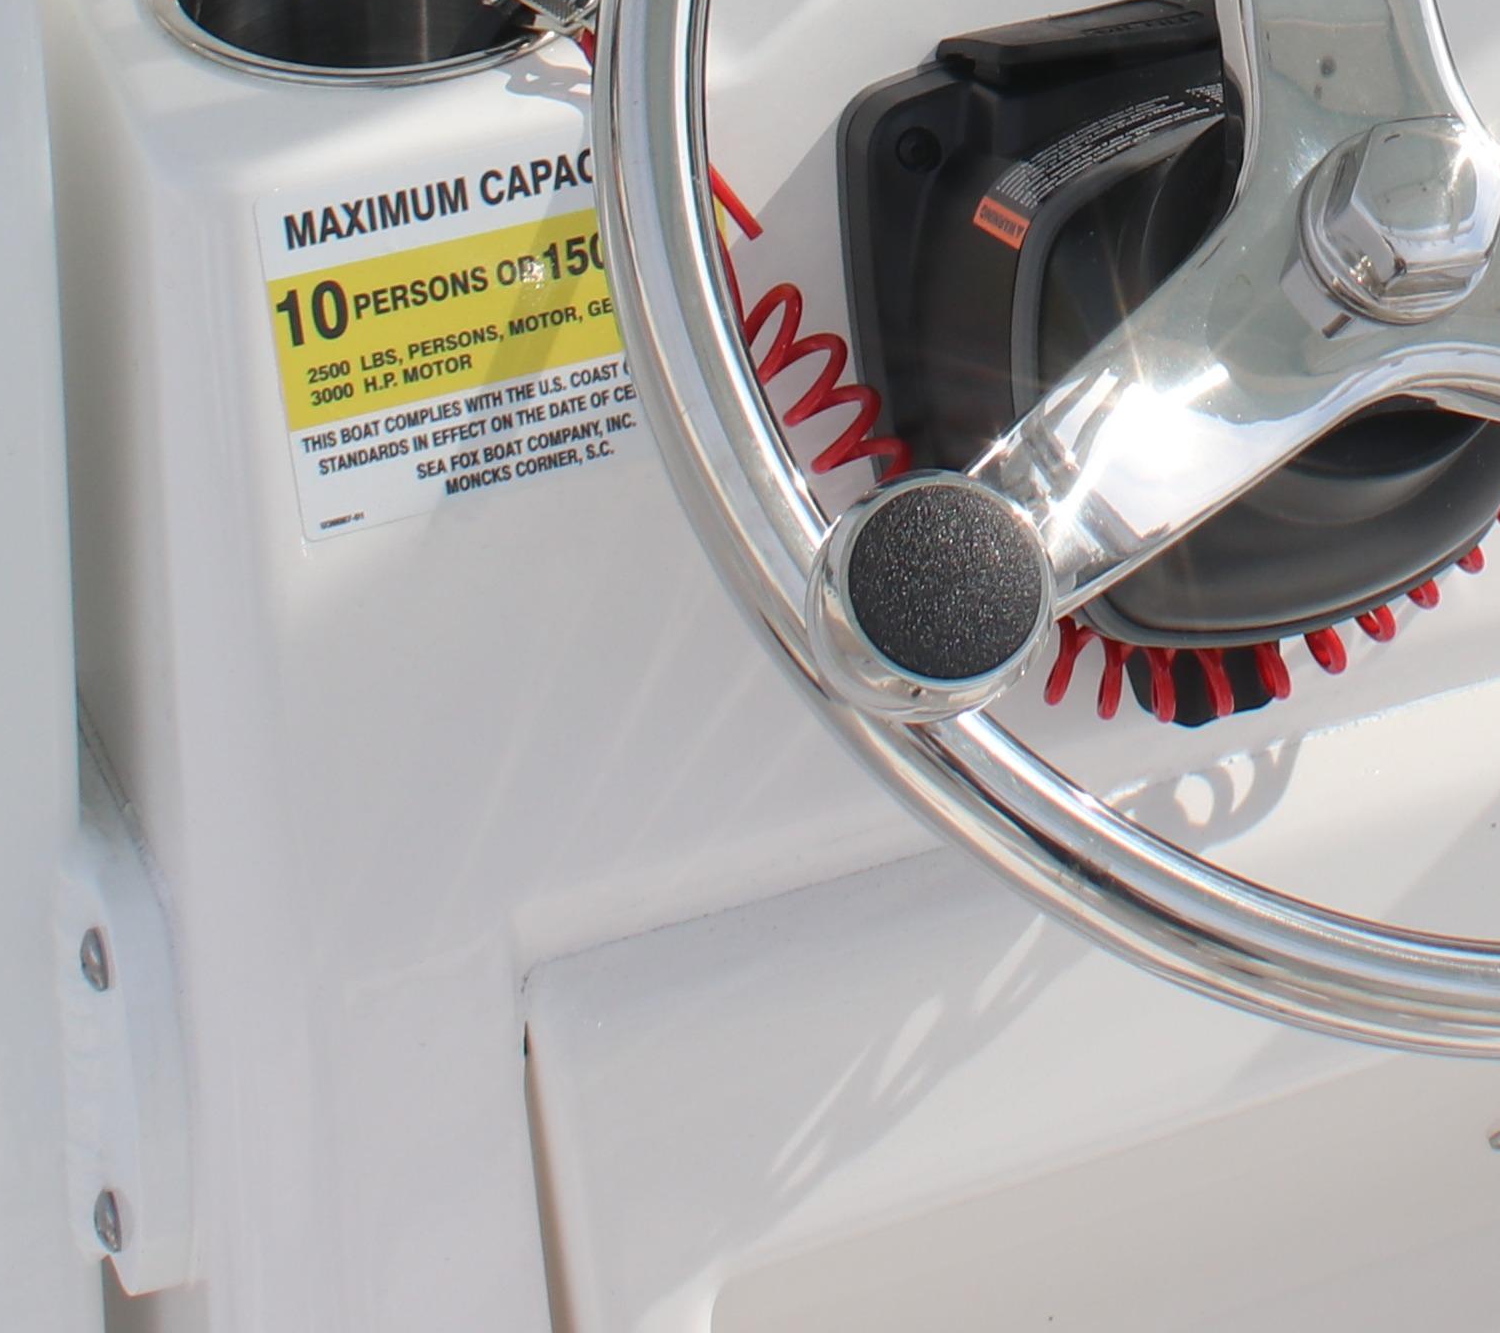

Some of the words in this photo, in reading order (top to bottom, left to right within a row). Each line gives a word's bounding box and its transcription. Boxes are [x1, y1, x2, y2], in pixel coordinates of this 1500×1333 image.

[283, 175, 470, 251] MAXIMUM
[274, 276, 351, 350] 10
[352, 264, 489, 320] PERSONS
[306, 359, 350, 384] 2500
[360, 347, 403, 374] LBS,
[407, 323, 504, 362] PERSONS,
[508, 304, 583, 338] MOTOR,
[301, 429, 338, 453] THIS
[338, 418, 382, 444] BOAT
[382, 399, 462, 433] COMPLIES
[463, 389, 503, 414] WITH
[504, 381, 536, 404] THE
[537, 374, 567, 396] U.S.
[568, 362, 619, 389] COAST
[309, 382, 354, 407] 3000
[363, 371, 398, 393] H.P.
[402, 353, 472, 384] MOTOR
[318, 438, 410, 475] STANDARDS
[411, 432, 429, 453] IN
[430, 418, 488, 448] EFFECT
[489, 412, 514, 433] ON
[515, 404, 546, 427] THE
[547, 394, 587, 419] DATE
[588, 388, 611, 409] OF
[416, 457, 447, 480] SEA
[448, 449, 481, 472] FOX
[481, 438, 524, 464] BOAT
[525, 419, 603, 455] COMPANY,
[604, 411, 636, 434] INC.
[445, 464, 513, 495] MONCKS
[513, 447, 583, 480] CORNER,
[584, 439, 614, 461] S.C.
